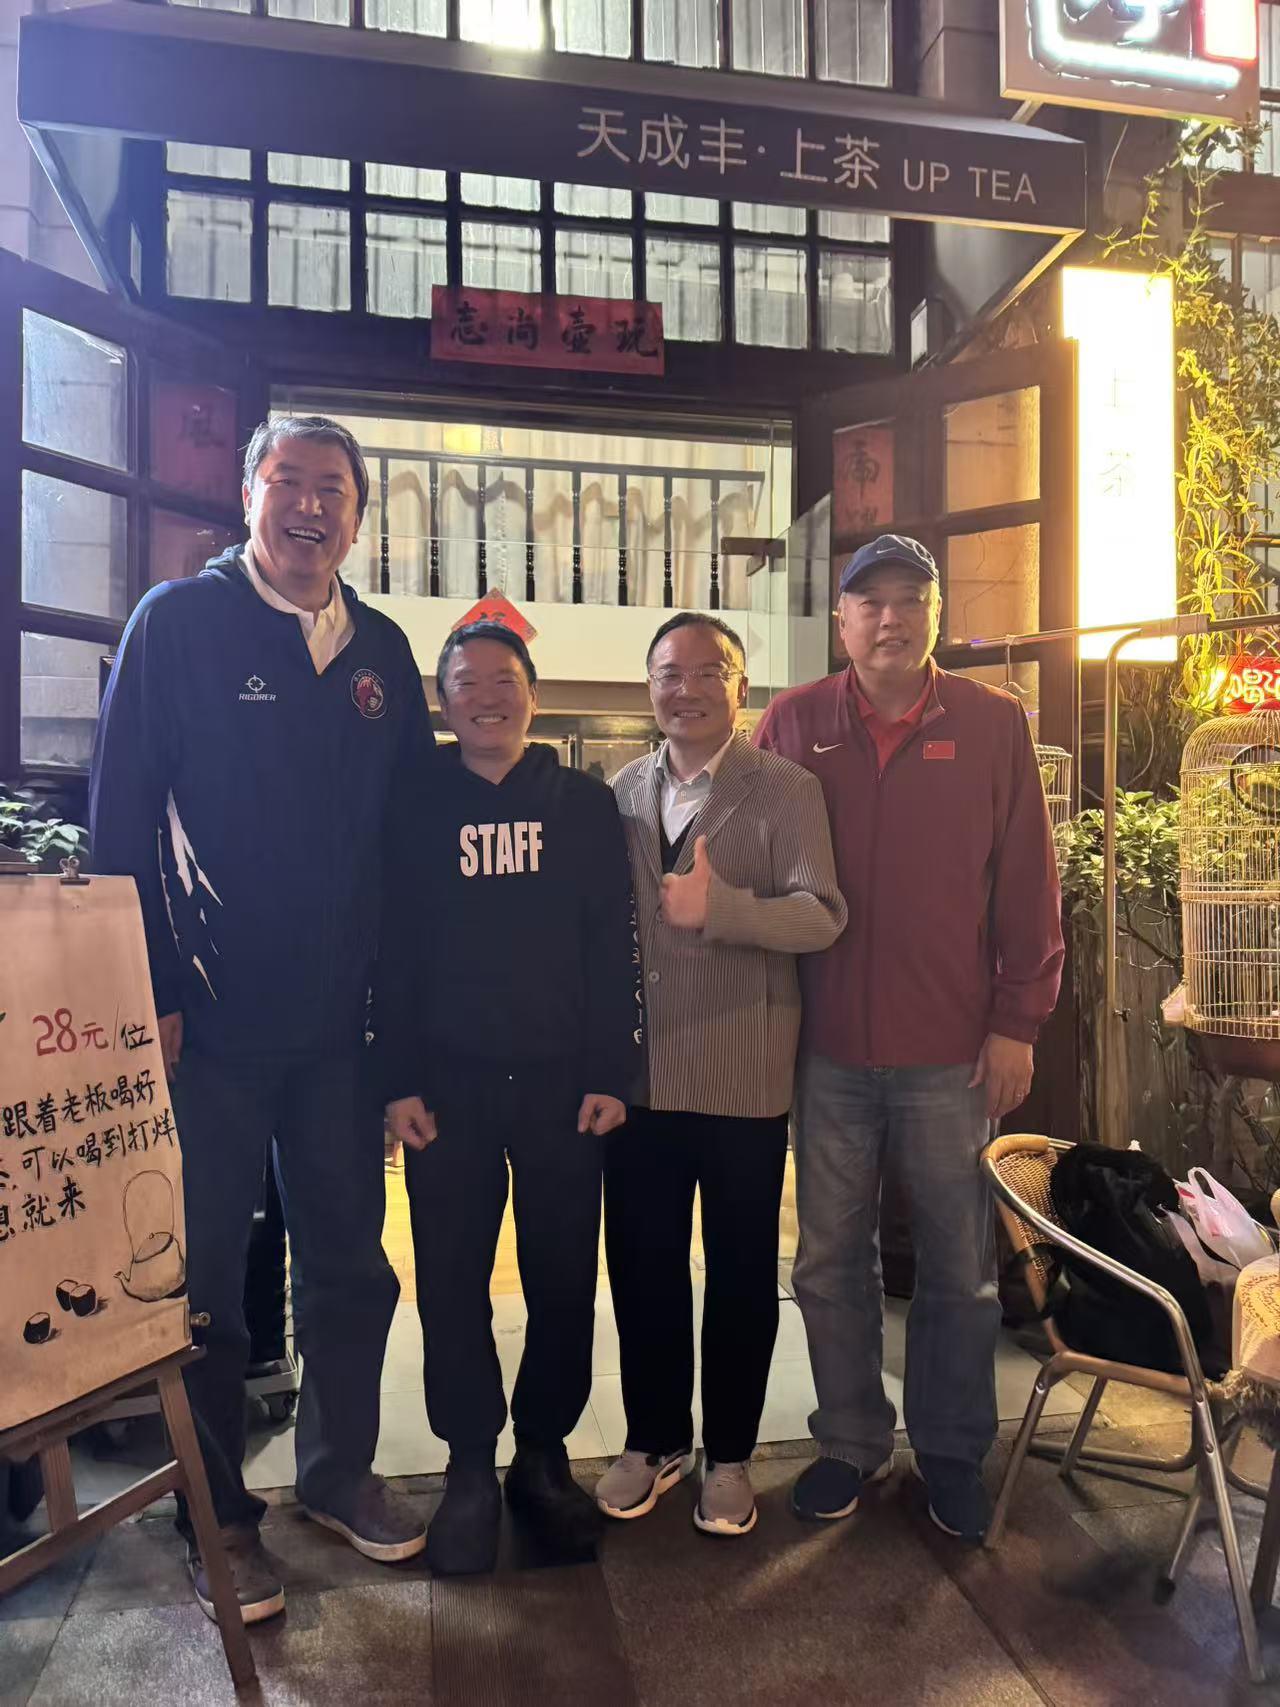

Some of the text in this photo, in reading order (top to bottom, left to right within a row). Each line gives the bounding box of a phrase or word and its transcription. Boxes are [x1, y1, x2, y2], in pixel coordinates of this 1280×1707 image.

[902, 158, 950, 192] UP
[967, 167, 1037, 205] TEA
[238, 693, 277, 701] RIGORER
[459, 821, 543, 877] STAFF
[3, 1069, 156, 1140] 跟着老板喝好
